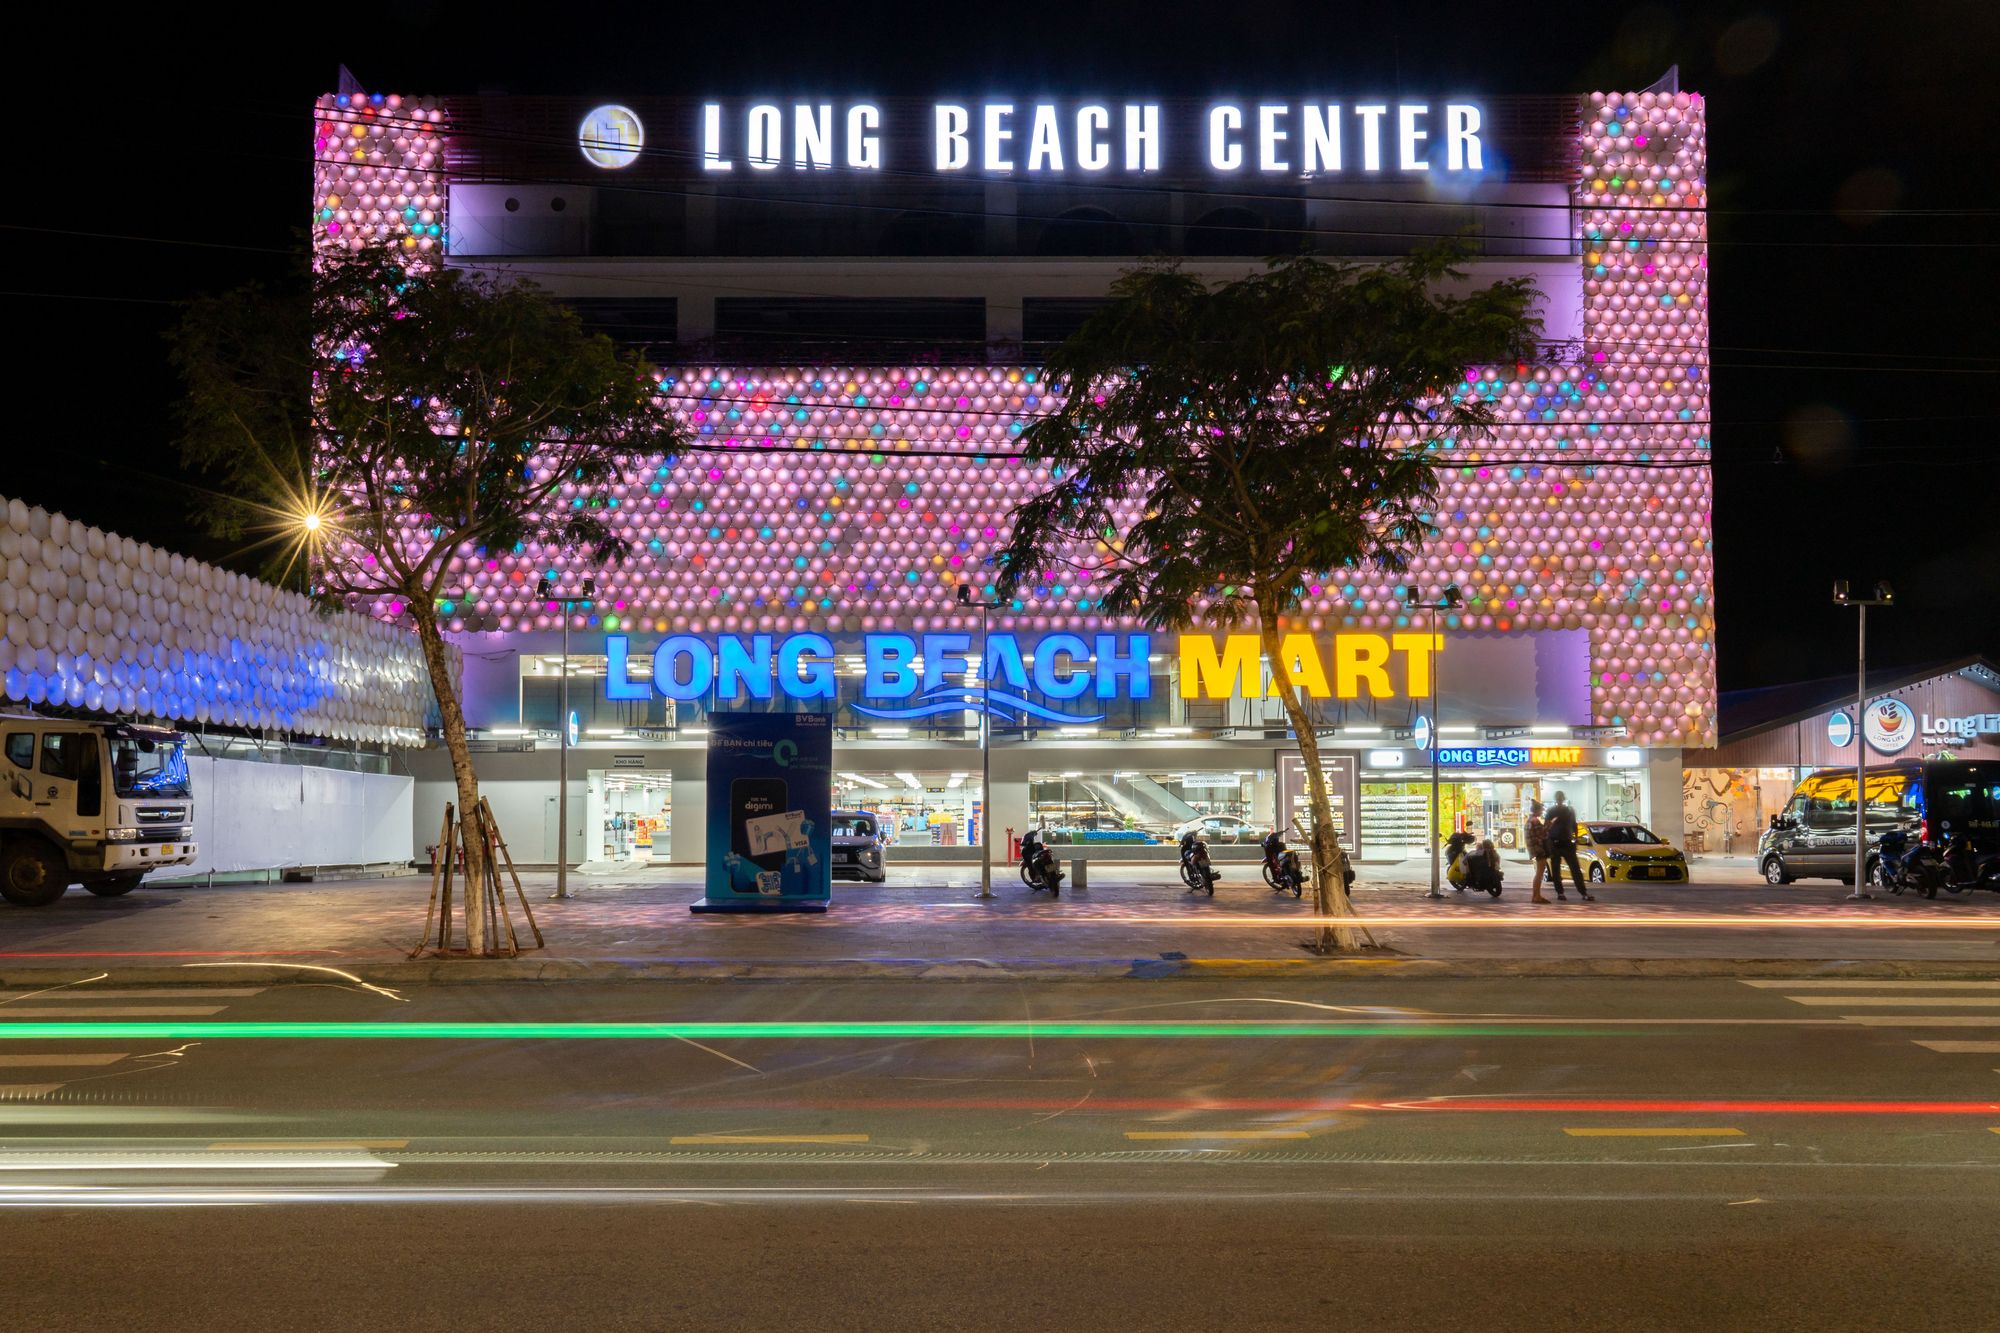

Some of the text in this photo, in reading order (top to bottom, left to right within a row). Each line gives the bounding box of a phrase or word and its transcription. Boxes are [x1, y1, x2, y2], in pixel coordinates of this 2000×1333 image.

[704, 104, 1483, 170] LONG BEACH CENTER
[606, 633, 1445, 700] LONG BEACH MART
[1921, 714, 1977, 738] Long
[525, 742, 532, 751] P
[1476, 749, 1529, 762] BEACH
[1531, 748, 1582, 763] MART
